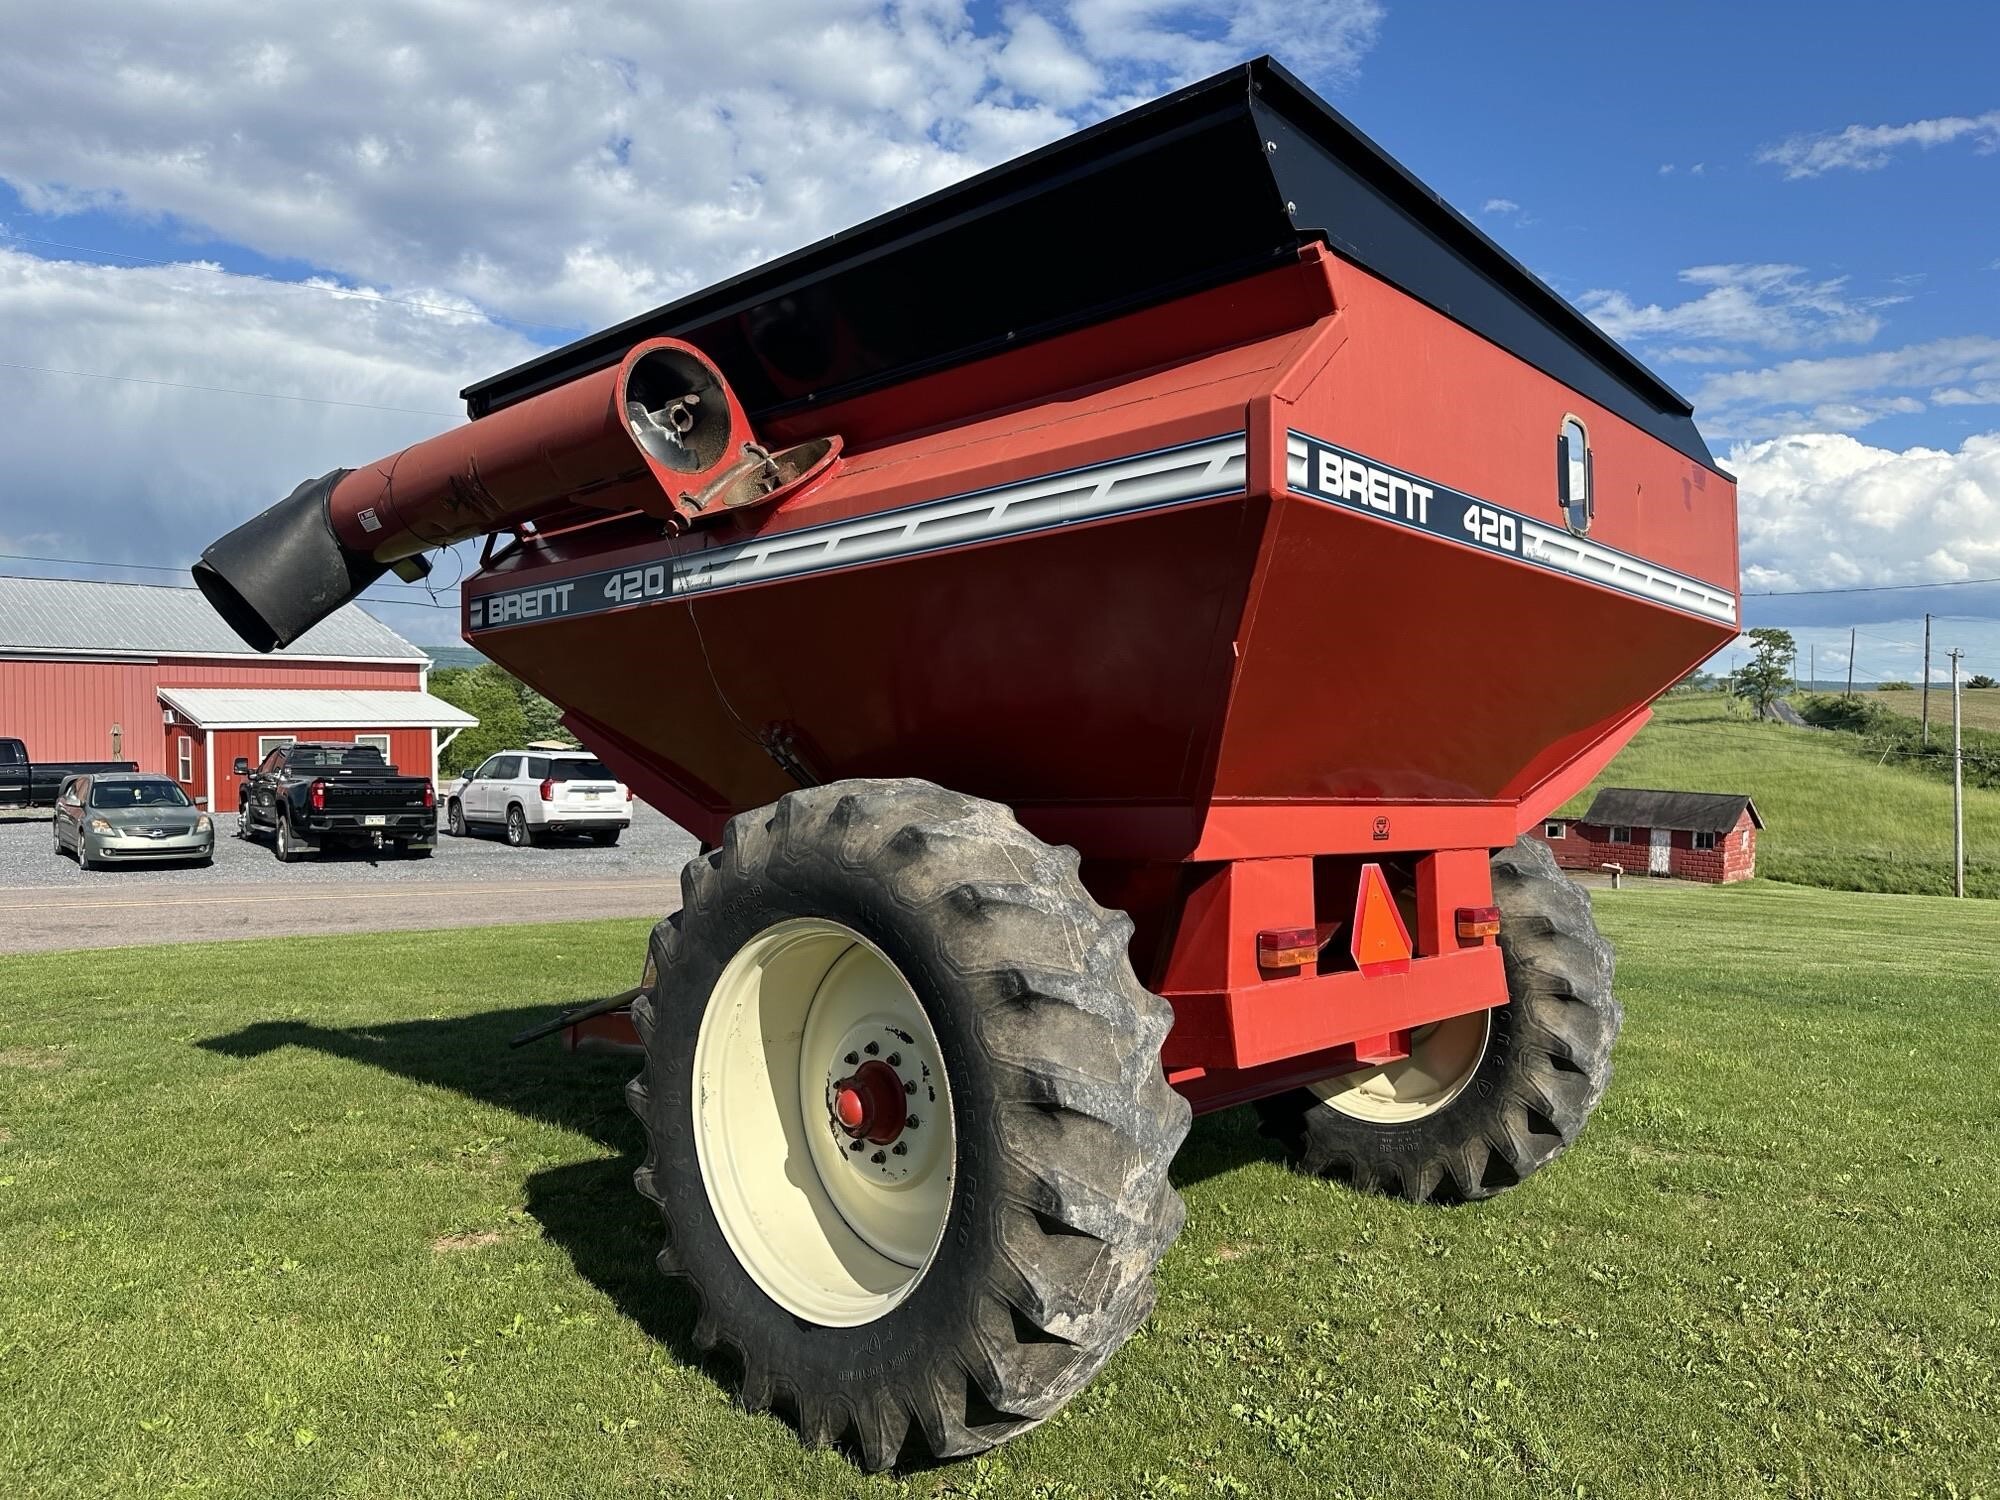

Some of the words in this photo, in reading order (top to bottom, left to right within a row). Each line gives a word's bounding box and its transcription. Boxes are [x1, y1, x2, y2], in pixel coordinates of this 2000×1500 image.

[1319, 449, 1433, 524] BRENT
[1463, 505, 1516, 551] 420
[490, 584, 574, 624] BRENT
[604, 565, 664, 601] 420
